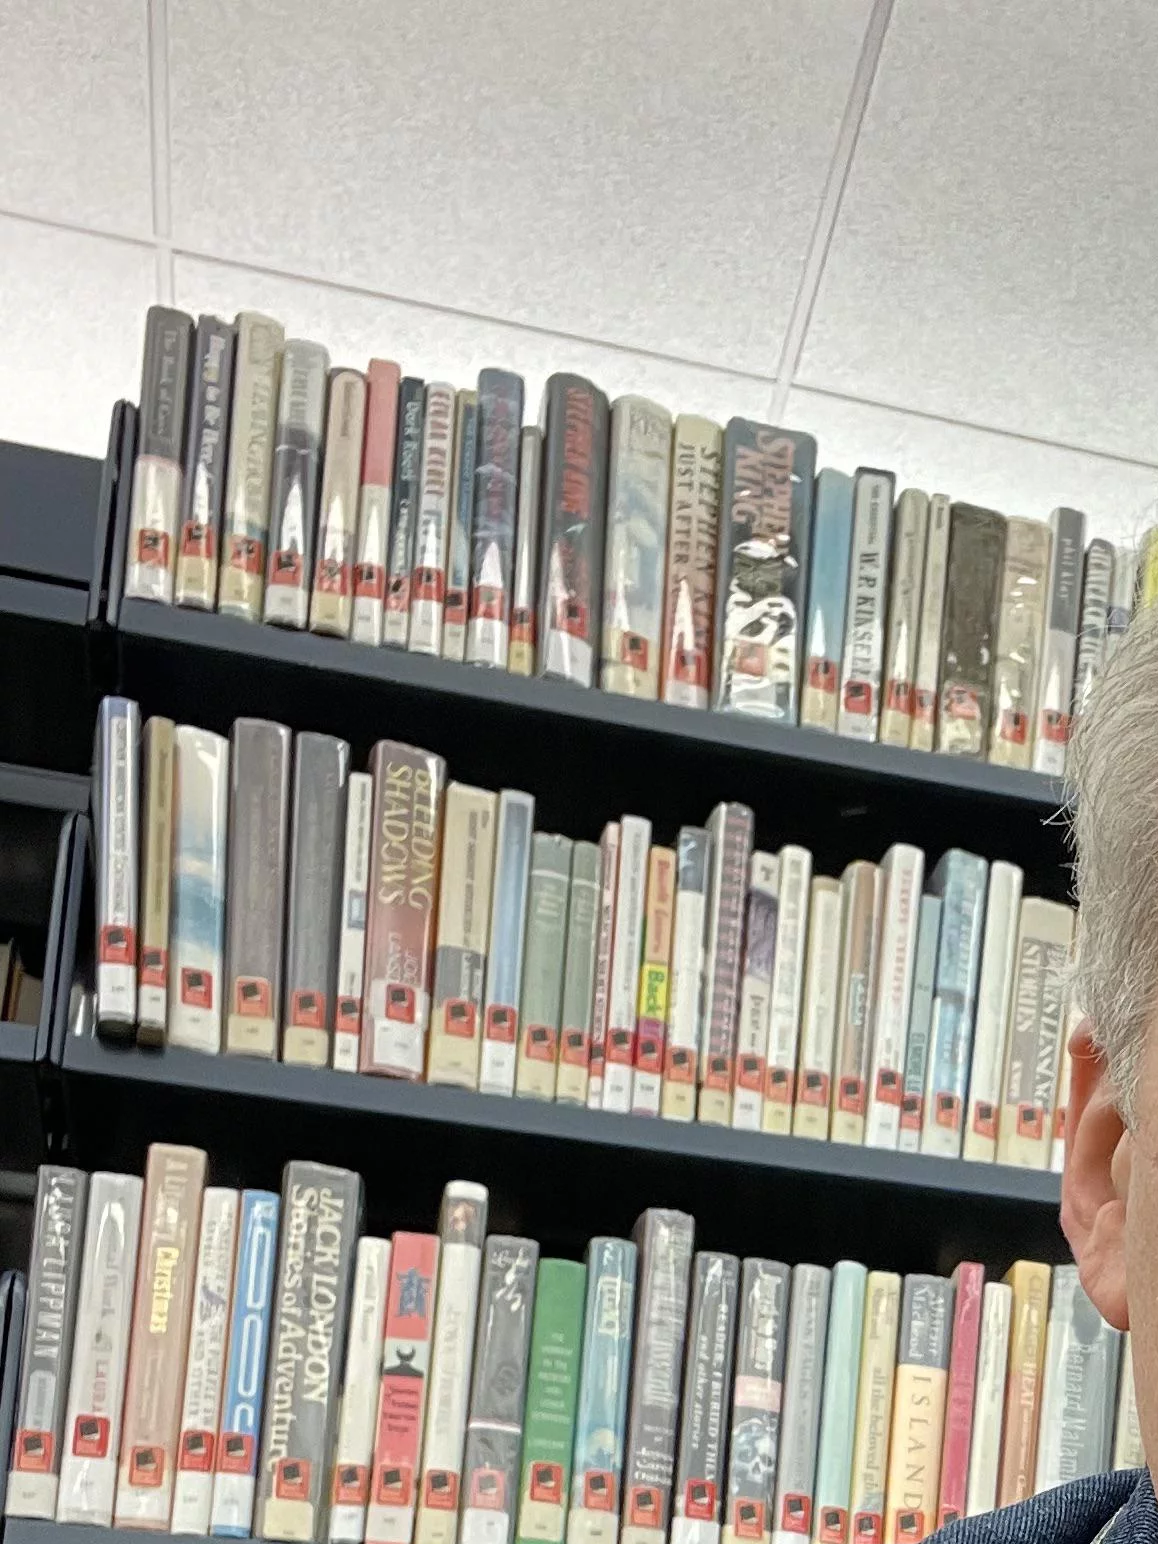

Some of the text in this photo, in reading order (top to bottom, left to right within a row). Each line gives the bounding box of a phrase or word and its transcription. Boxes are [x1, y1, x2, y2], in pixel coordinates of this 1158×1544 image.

[677, 443, 696, 489] JUST
[731, 445, 764, 526] KING
[752, 429, 795, 548] STEPHEN
[673, 498, 694, 566] AFTER
[695, 446, 721, 573] STEPHEN
[851, 595, 878, 680] KINSELL
[379, 761, 413, 906] SHADOWS
[408, 767, 437, 910] BLEEDING
[1016, 942, 1040, 1032] STORIES
[284, 1184, 318, 1289] Stories
[33, 1256, 65, 1359] LIPPMAN
[281, 1291, 302, 1315] of
[303, 1188, 345, 1404] JACK LONDON
[908, 1286, 930, 1359] MacLeod
[928, 1294, 945, 1357] Alistair
[691, 1335, 709, 1450] and other stories
[708, 1381, 721, 1437] BURIED
[871, 1388, 885, 1411] the
[873, 1366, 886, 1384] all
[866, 1414, 884, 1471] beloved
[903, 1374, 932, 1511] ISLAND
